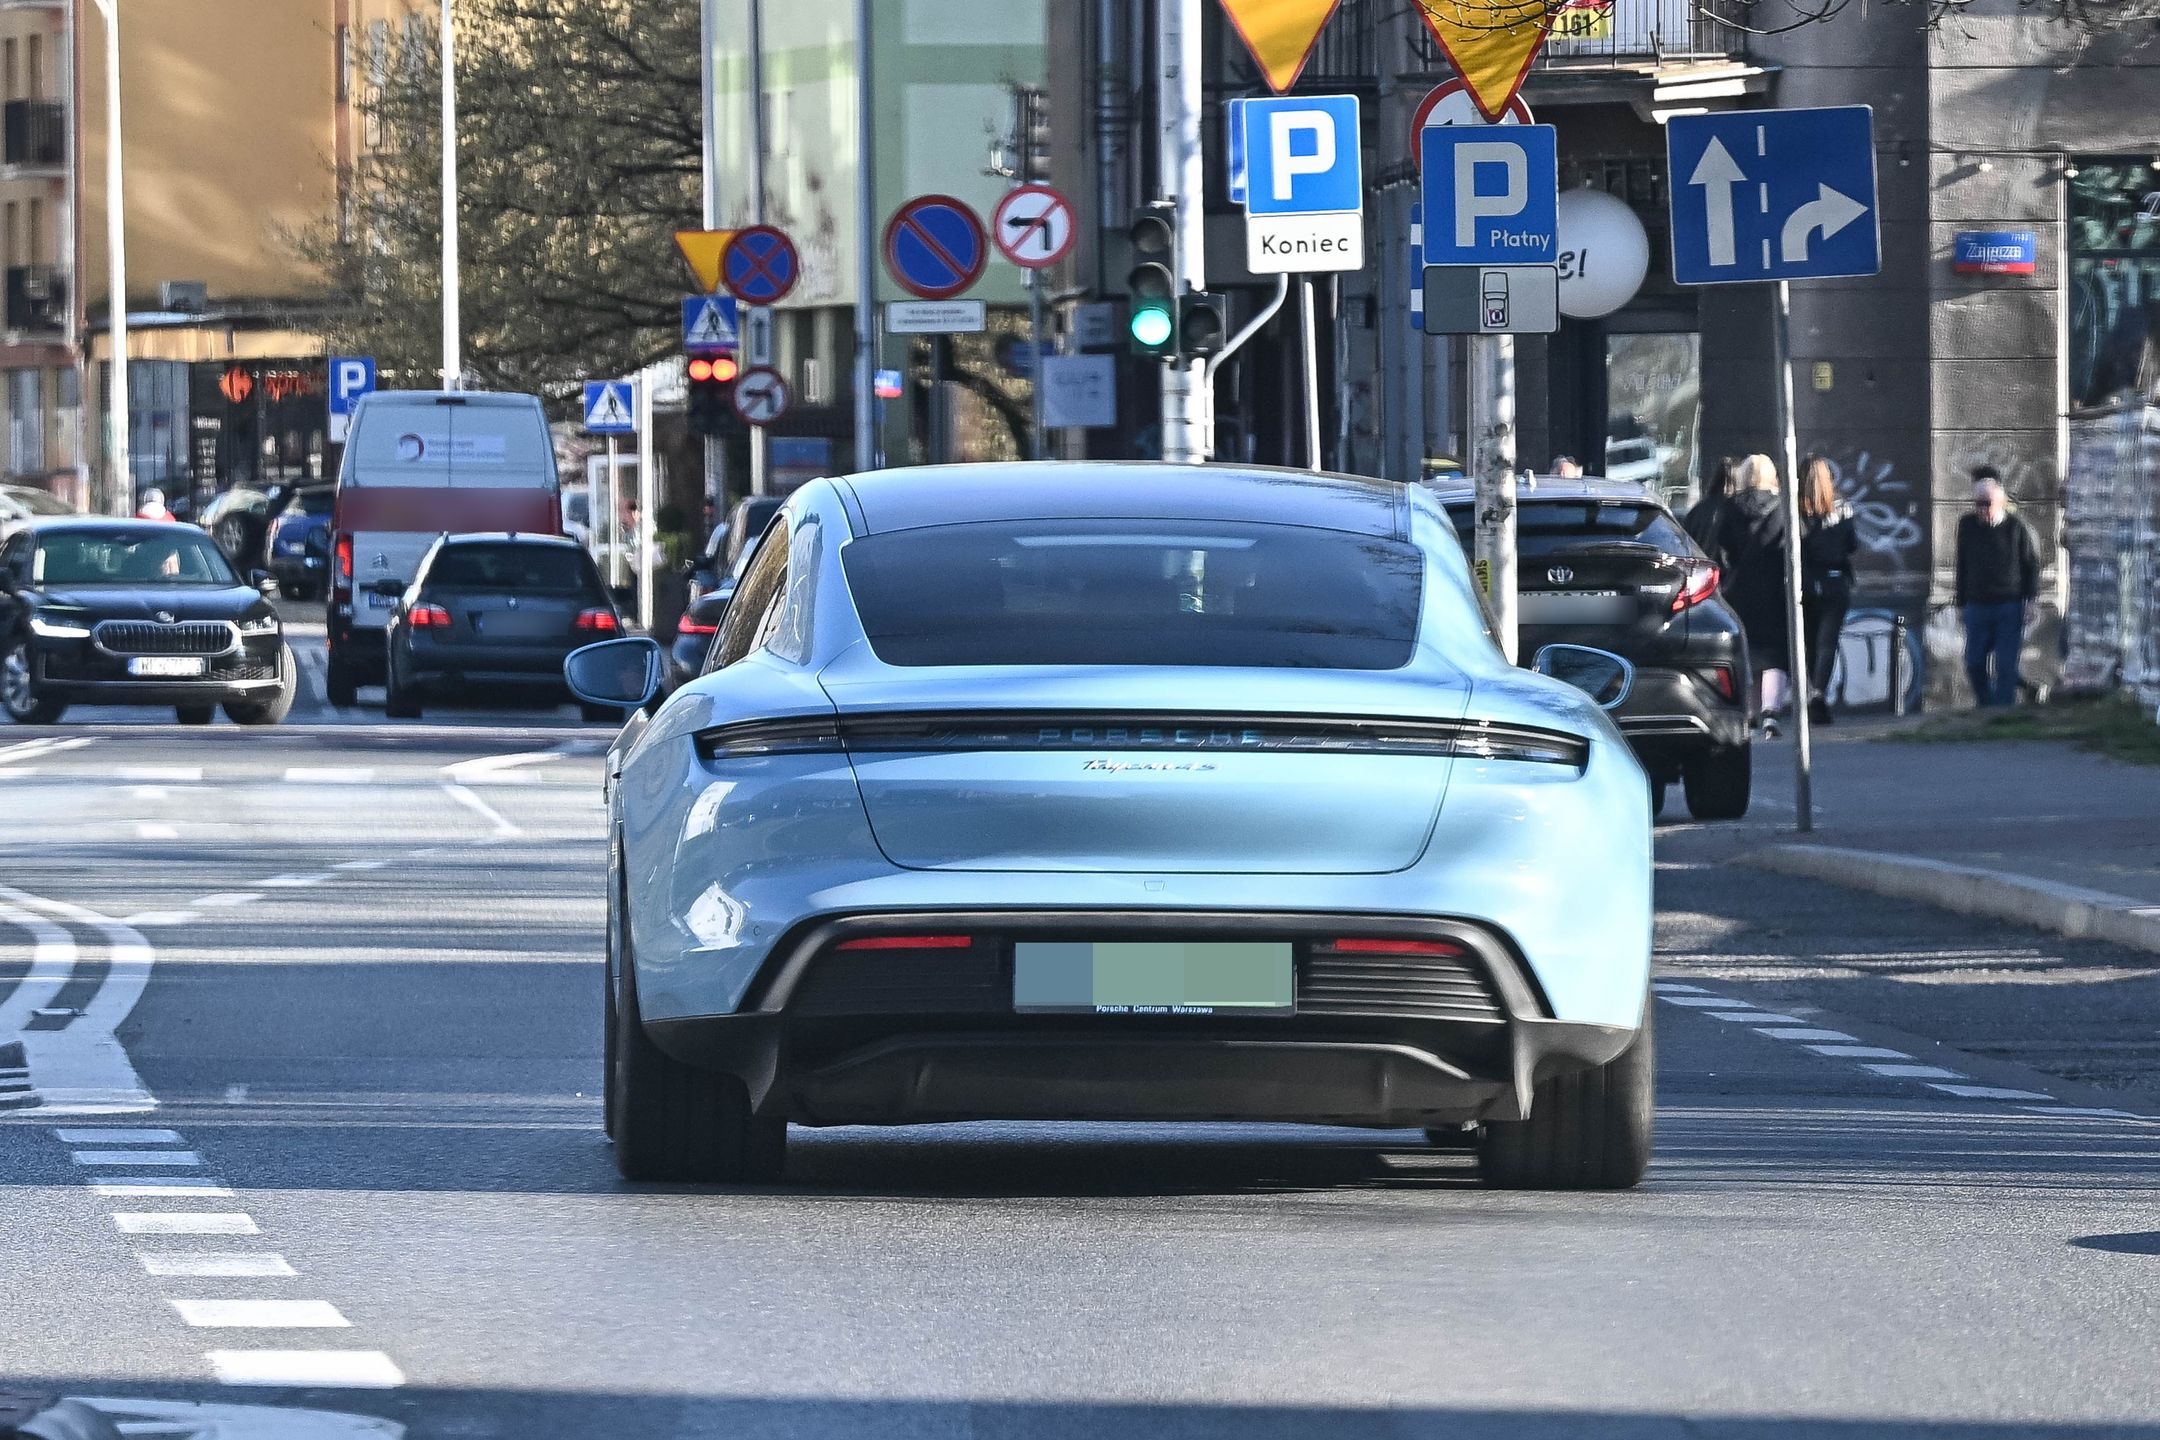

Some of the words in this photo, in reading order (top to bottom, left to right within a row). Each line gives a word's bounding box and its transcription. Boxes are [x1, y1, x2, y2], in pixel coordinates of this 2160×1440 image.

[1271, 110, 1336, 200] P
[1454, 141, 1528, 247] P
[1262, 233, 1349, 255] Koniec
[1490, 229, 1551, 252] Płatny
[340, 361, 366, 400] P
[1038, 727, 1263, 746] PORSCHE
[1096, 1004, 1129, 1014] Porsche
[1133, 1004, 1168, 1014] Centrum
[1172, 1004, 1213, 1015] Warszawa
